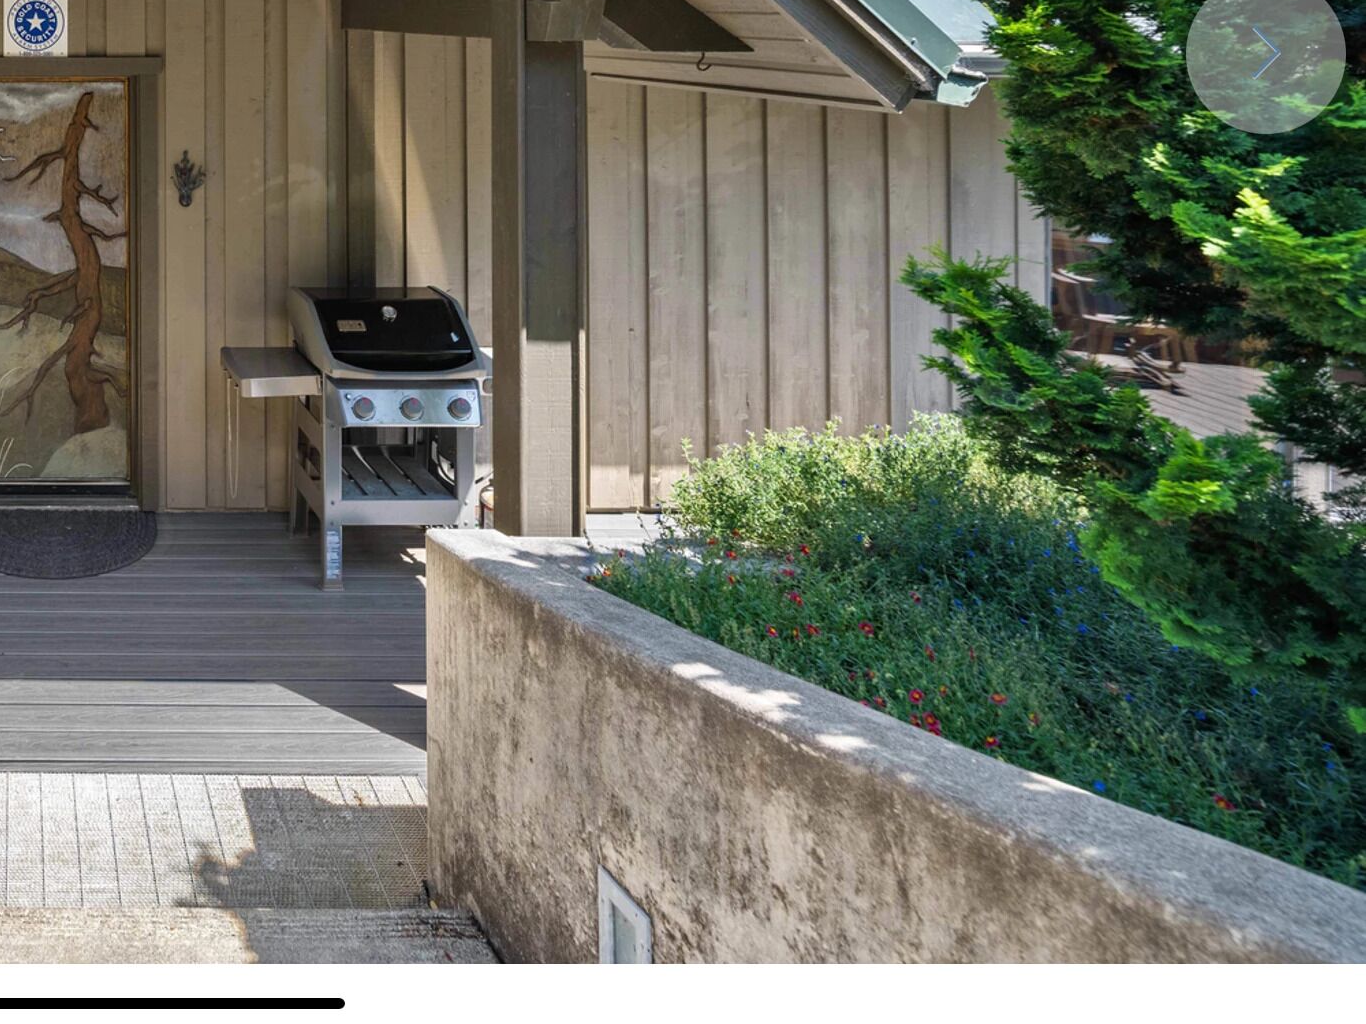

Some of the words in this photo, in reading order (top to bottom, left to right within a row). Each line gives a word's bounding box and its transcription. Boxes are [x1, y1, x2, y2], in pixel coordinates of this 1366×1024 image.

[17, 3, 33, 23] GOLD
[34, 2, 56, 23] COAST
[17, 25, 55, 43] SECURITY
